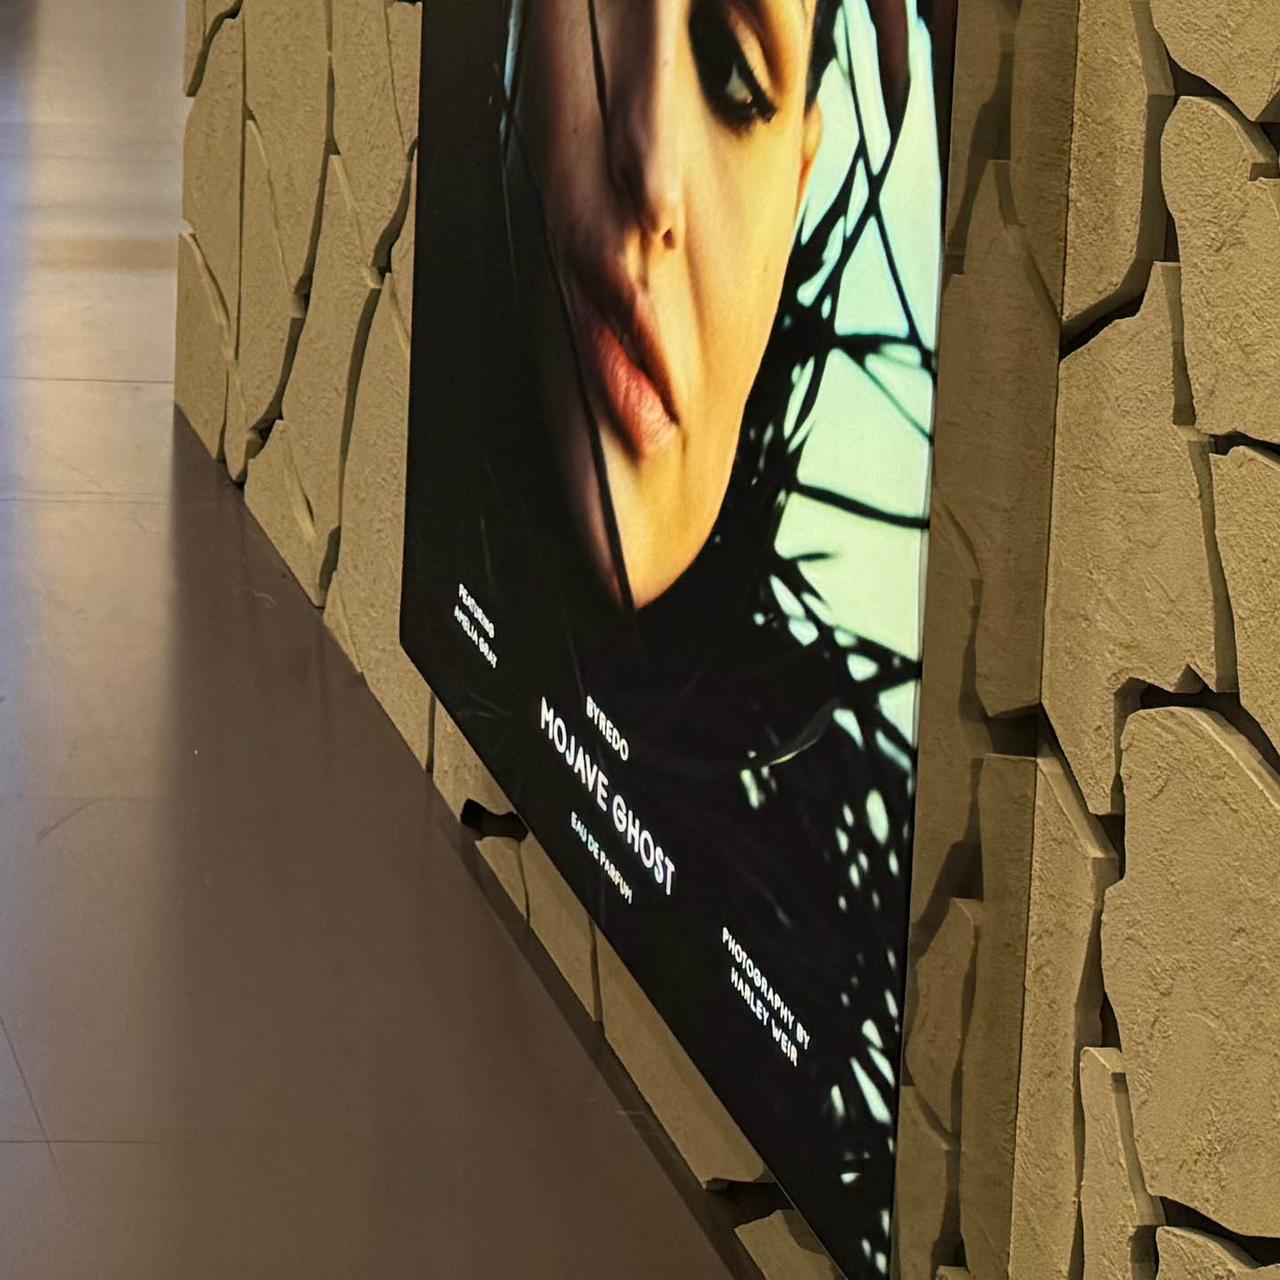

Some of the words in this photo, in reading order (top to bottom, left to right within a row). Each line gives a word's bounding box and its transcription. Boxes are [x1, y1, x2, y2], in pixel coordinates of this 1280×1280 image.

[586, 695, 629, 761] BYREDO
[541, 695, 609, 812] MOJAVE
[611, 793, 676, 896] GHOST
[570, 811, 587, 843] EAU
[587, 833, 600, 860] DE
[599, 849, 633, 905] PARFUM
[722, 926, 795, 1030] PHOTOGRAPHY
[795, 1022, 811, 1050] BY
[730, 966, 770, 1026] HARLEY
[771, 1018, 798, 1067] WEIR
